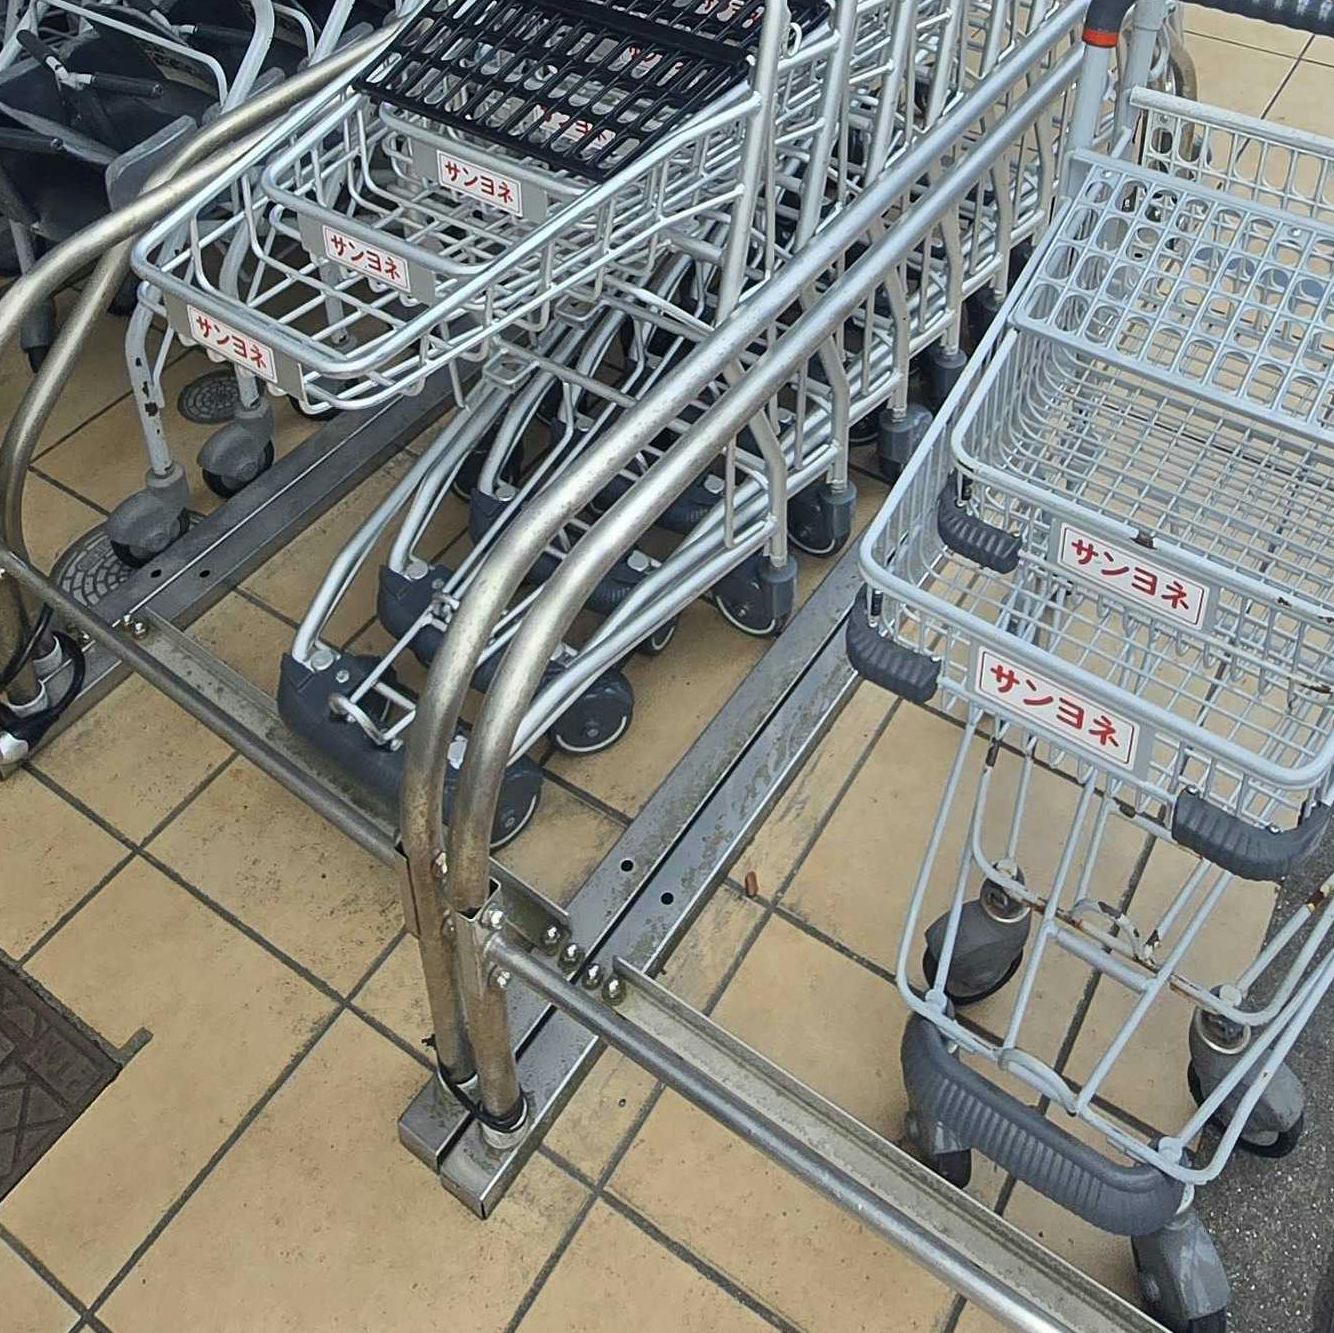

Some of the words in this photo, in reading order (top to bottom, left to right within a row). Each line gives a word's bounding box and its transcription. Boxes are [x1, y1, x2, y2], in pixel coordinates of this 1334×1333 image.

[444, 159, 516, 204] サンヨネ
[330, 233, 402, 281] サンヨネ
[195, 315, 269, 369] サンヨネ
[1070, 538, 1190, 611] サンヨネ
[989, 663, 1120, 749] サンヨネ
